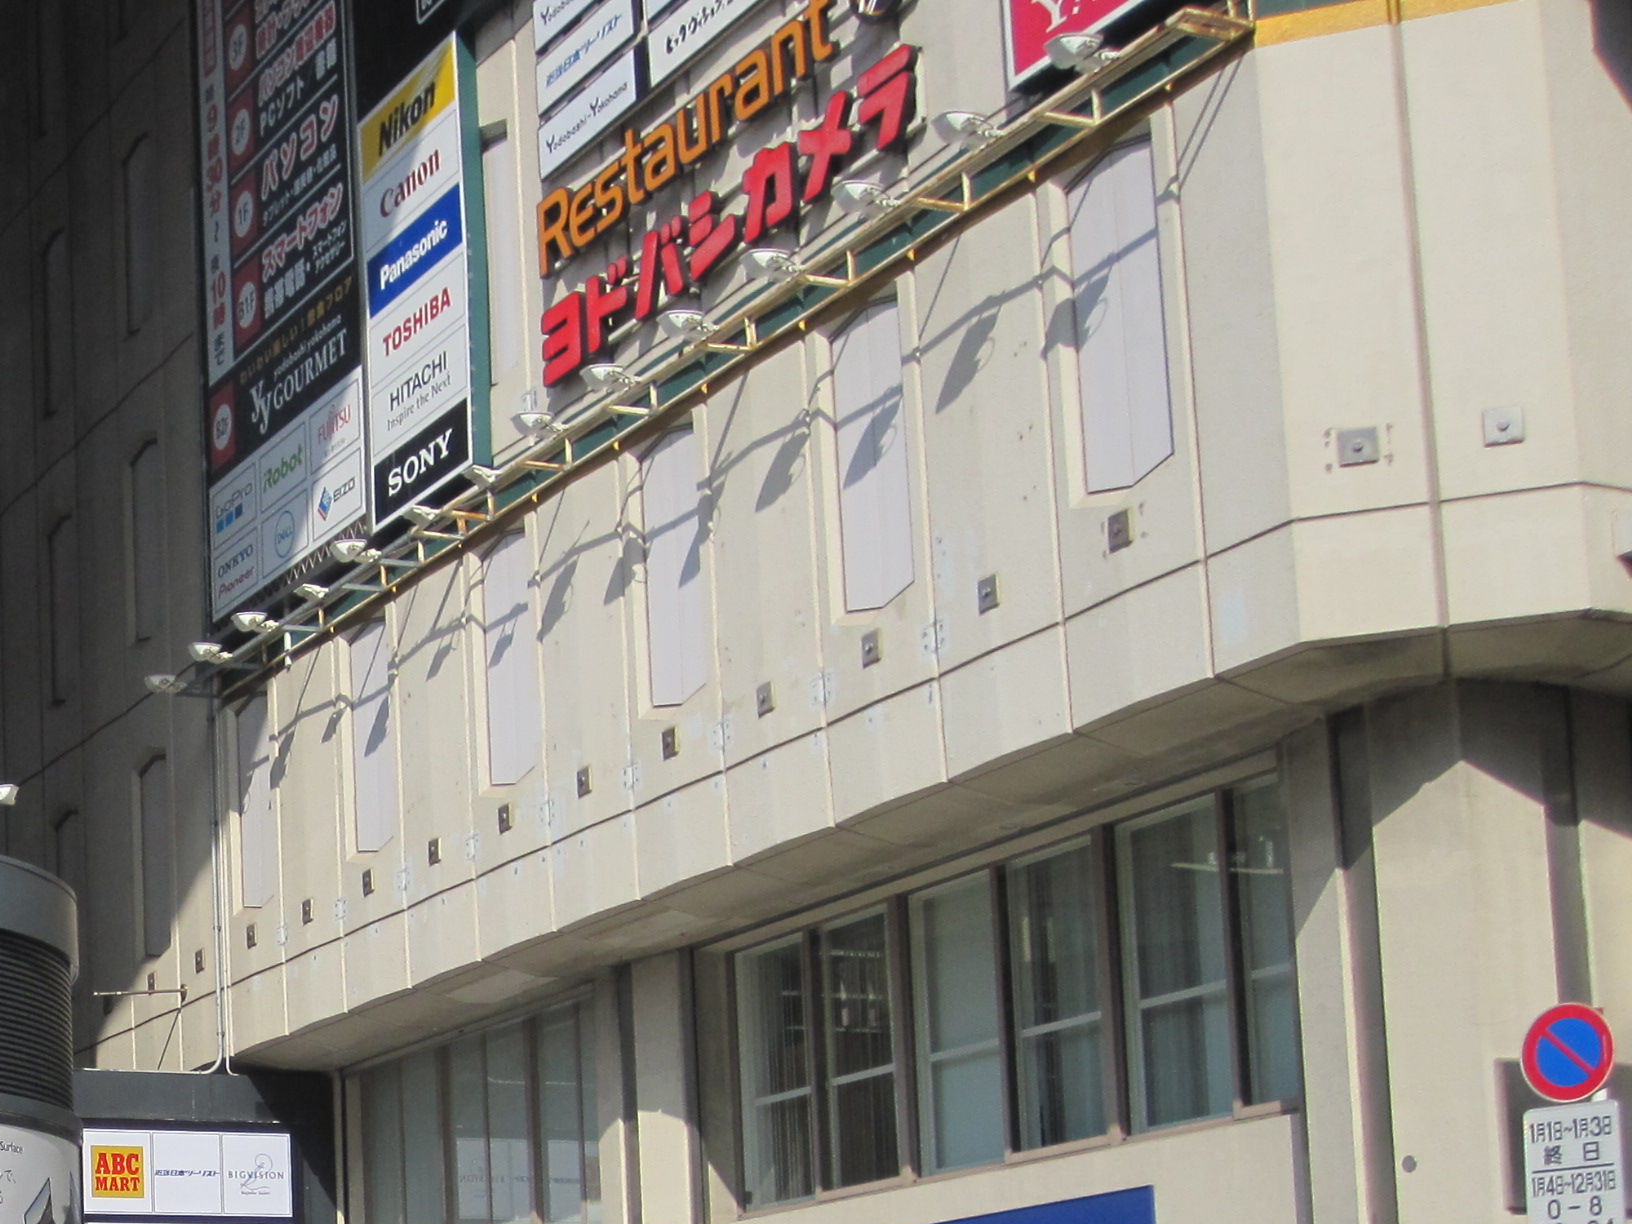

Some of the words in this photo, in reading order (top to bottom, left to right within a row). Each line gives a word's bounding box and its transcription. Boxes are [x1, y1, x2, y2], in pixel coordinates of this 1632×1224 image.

[378, 81, 436, 156] Nikon
[537, 0, 834, 277] Restaurant
[380, 149, 441, 218] Canon
[541, 44, 912, 389] ヨドバシカメラ
[380, 219, 448, 291] Panasonic
[382, 286, 451, 358] TOSHIBA
[274, 328, 347, 410] GOURMET
[389, 350, 447, 412] HITACHI
[388, 428, 453, 496] SONY
[218, 544, 254, 578] ONKYO
[218, 565, 255, 598] Pioneer
[0, 1141, 24, 1155] Surface
[95, 1152, 139, 1176] ABC
[95, 1177, 140, 1192] MART
